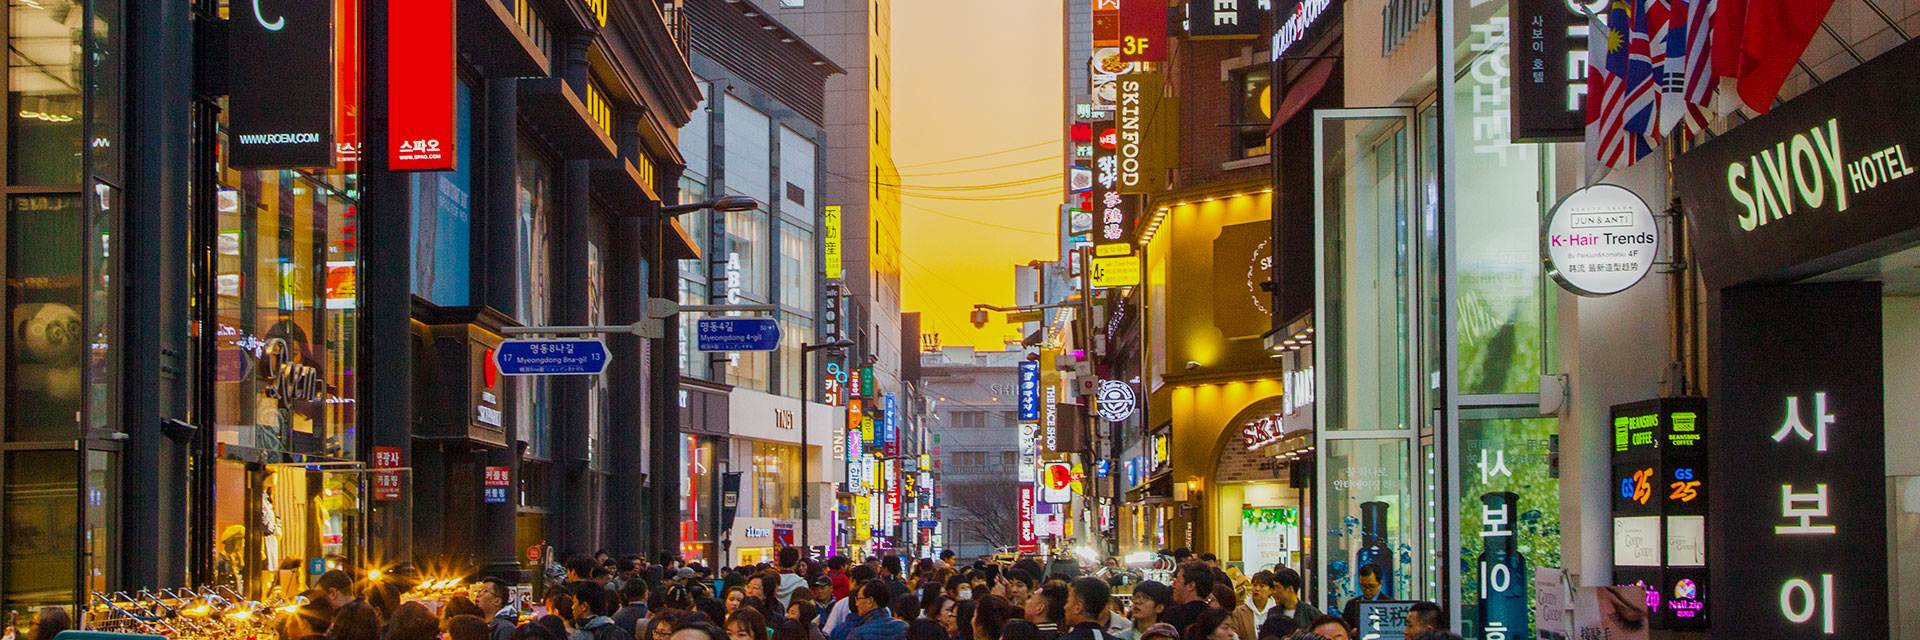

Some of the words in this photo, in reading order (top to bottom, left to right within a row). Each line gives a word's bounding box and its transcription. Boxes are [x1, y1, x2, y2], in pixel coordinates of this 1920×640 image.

[1272, 13, 1297, 62] HOLLYS
[1531, 15, 1544, 52] 사보이
[1123, 36, 1149, 55] 3F
[1531, 59, 1544, 83] 호텔
[240, 133, 319, 144] WWW.ROEM.COM
[1122, 81, 1139, 187] SKINFOOD
[399, 139, 441, 152] 스파오
[1728, 118, 1848, 231] SAVOY
[1848, 144, 1914, 193] HOTEL
[1551, 233, 1599, 247] K-Hair
[1603, 232, 1655, 245] Trends
[700, 321, 734, 332] 명동4길
[700, 334, 745, 342] Myeongdong
[503, 353, 513, 362] 17
[529, 343, 575, 355] 명동8나길
[591, 352, 601, 361] 13
[516, 356, 562, 365] Myeongdong
[563, 355, 588, 364] 8na-gil
[1046, 385, 1056, 401] THE
[775, 408, 794, 430] TNGT
[1046, 402, 1056, 427] FACE
[1046, 428, 1056, 451] SHOP
[1242, 412, 1284, 450] SKI
[1632, 431, 1653, 446] COFFEE
[833, 428, 844, 461] TNGT
[1674, 468, 1694, 480] GS
[1669, 480, 1702, 502] 25
[1021, 488, 1032, 519] BEAUTY
[1771, 391, 1836, 634] 사보이
[1021, 521, 1032, 542] SHOP
